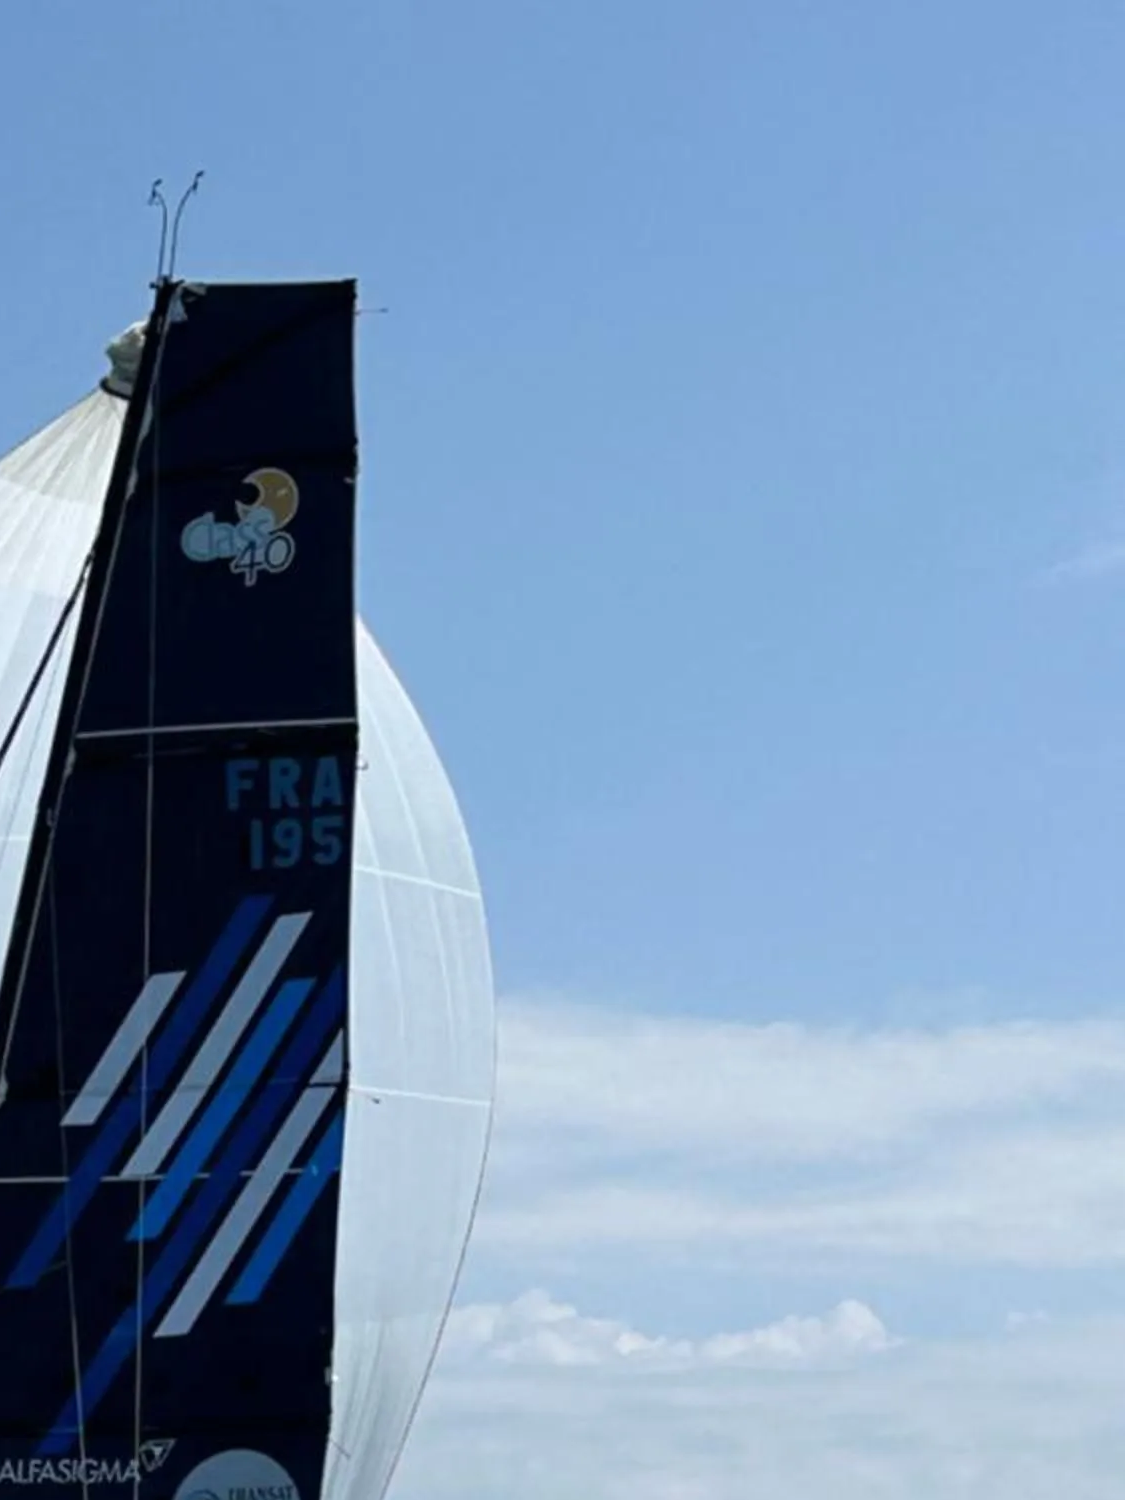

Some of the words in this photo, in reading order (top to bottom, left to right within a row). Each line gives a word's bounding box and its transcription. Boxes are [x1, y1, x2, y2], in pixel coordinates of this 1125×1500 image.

[183, 514, 274, 560] Class
[233, 533, 293, 584] 40
[225, 756, 343, 811] FRA
[249, 815, 344, 870] 195
